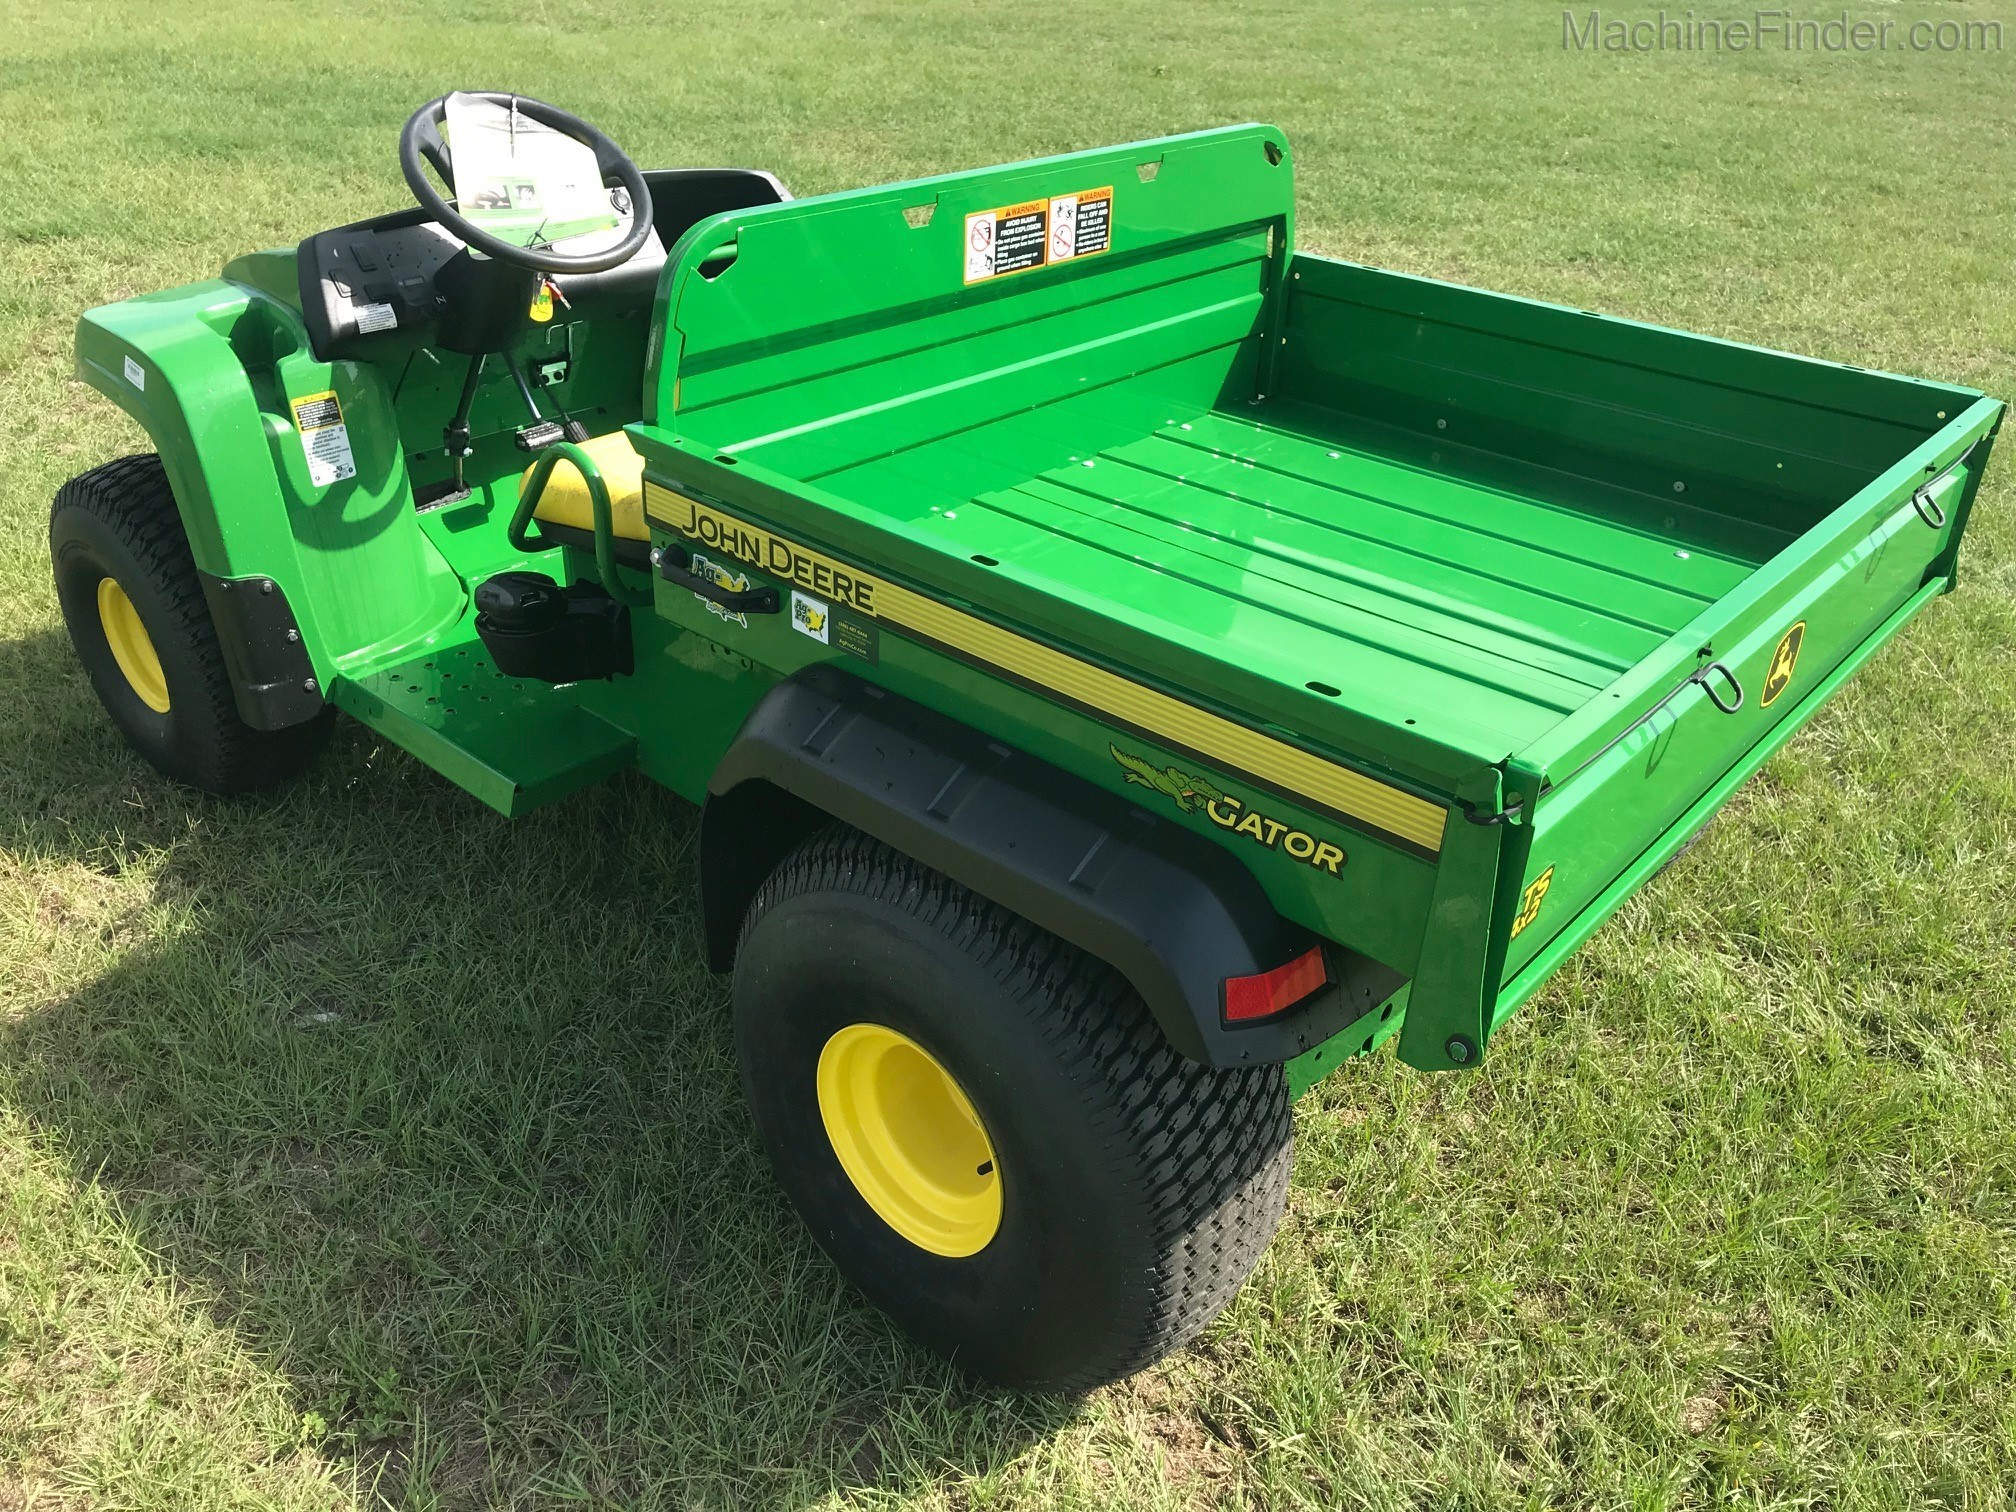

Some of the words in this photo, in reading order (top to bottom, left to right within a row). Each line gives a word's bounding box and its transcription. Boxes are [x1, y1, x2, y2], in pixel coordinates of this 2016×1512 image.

[1084, 188, 1111, 200] WARNING
[1011, 203, 1040, 215] WARNING
[1014, 222, 1042, 234] EXPLOSION
[681, 504, 761, 565] JOHN
[768, 536, 875, 612] DEERE
[1206, 795, 1345, 875] GATOR
[1524, 867, 1554, 913] TS
